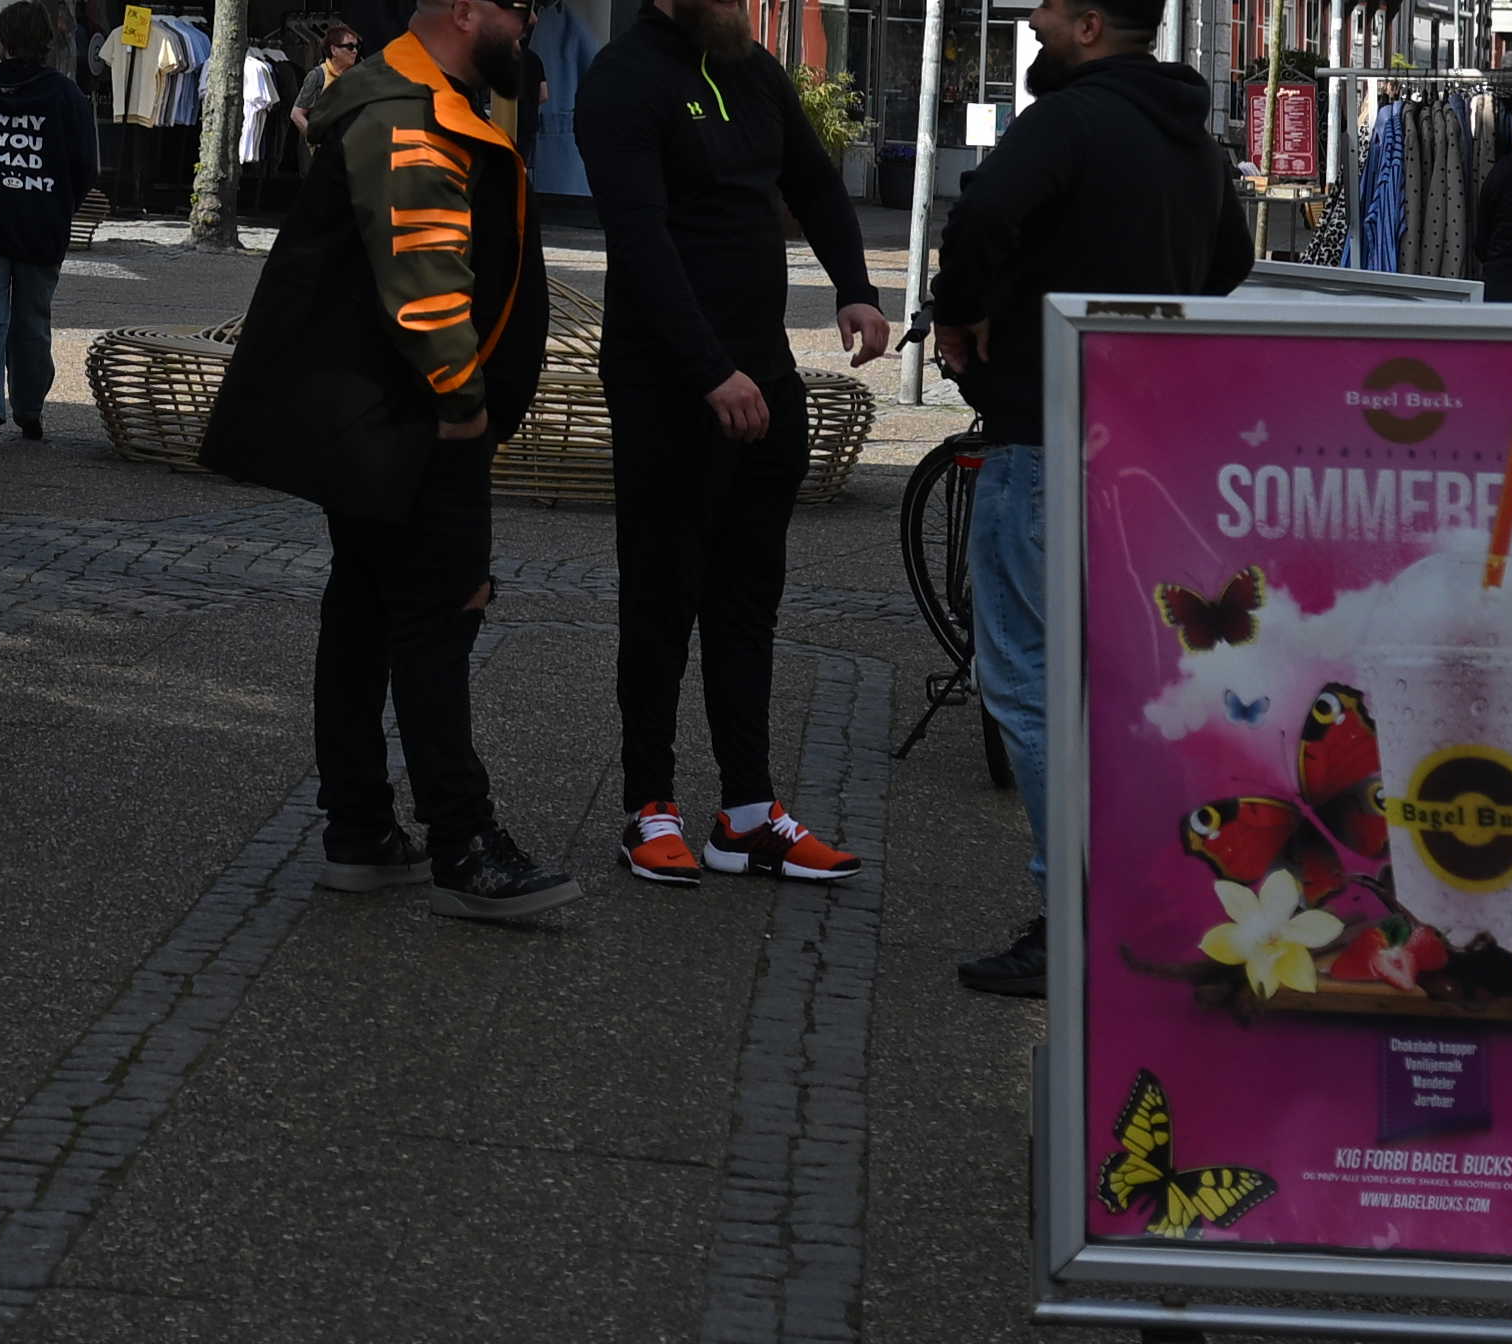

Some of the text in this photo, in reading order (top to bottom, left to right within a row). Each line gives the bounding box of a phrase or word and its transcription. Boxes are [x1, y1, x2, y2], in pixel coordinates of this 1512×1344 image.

[1345, 391, 1463, 409] Bagel Bucks
[1401, 802, 1465, 829] Bagel
[1334, 1148, 1361, 1169] KIG
[1363, 1149, 1408, 1172] FORBI
[1411, 1151, 1459, 1174] BAGEL
[1360, 1191, 1491, 1213] WWW.BAGELBUCKS.COM
